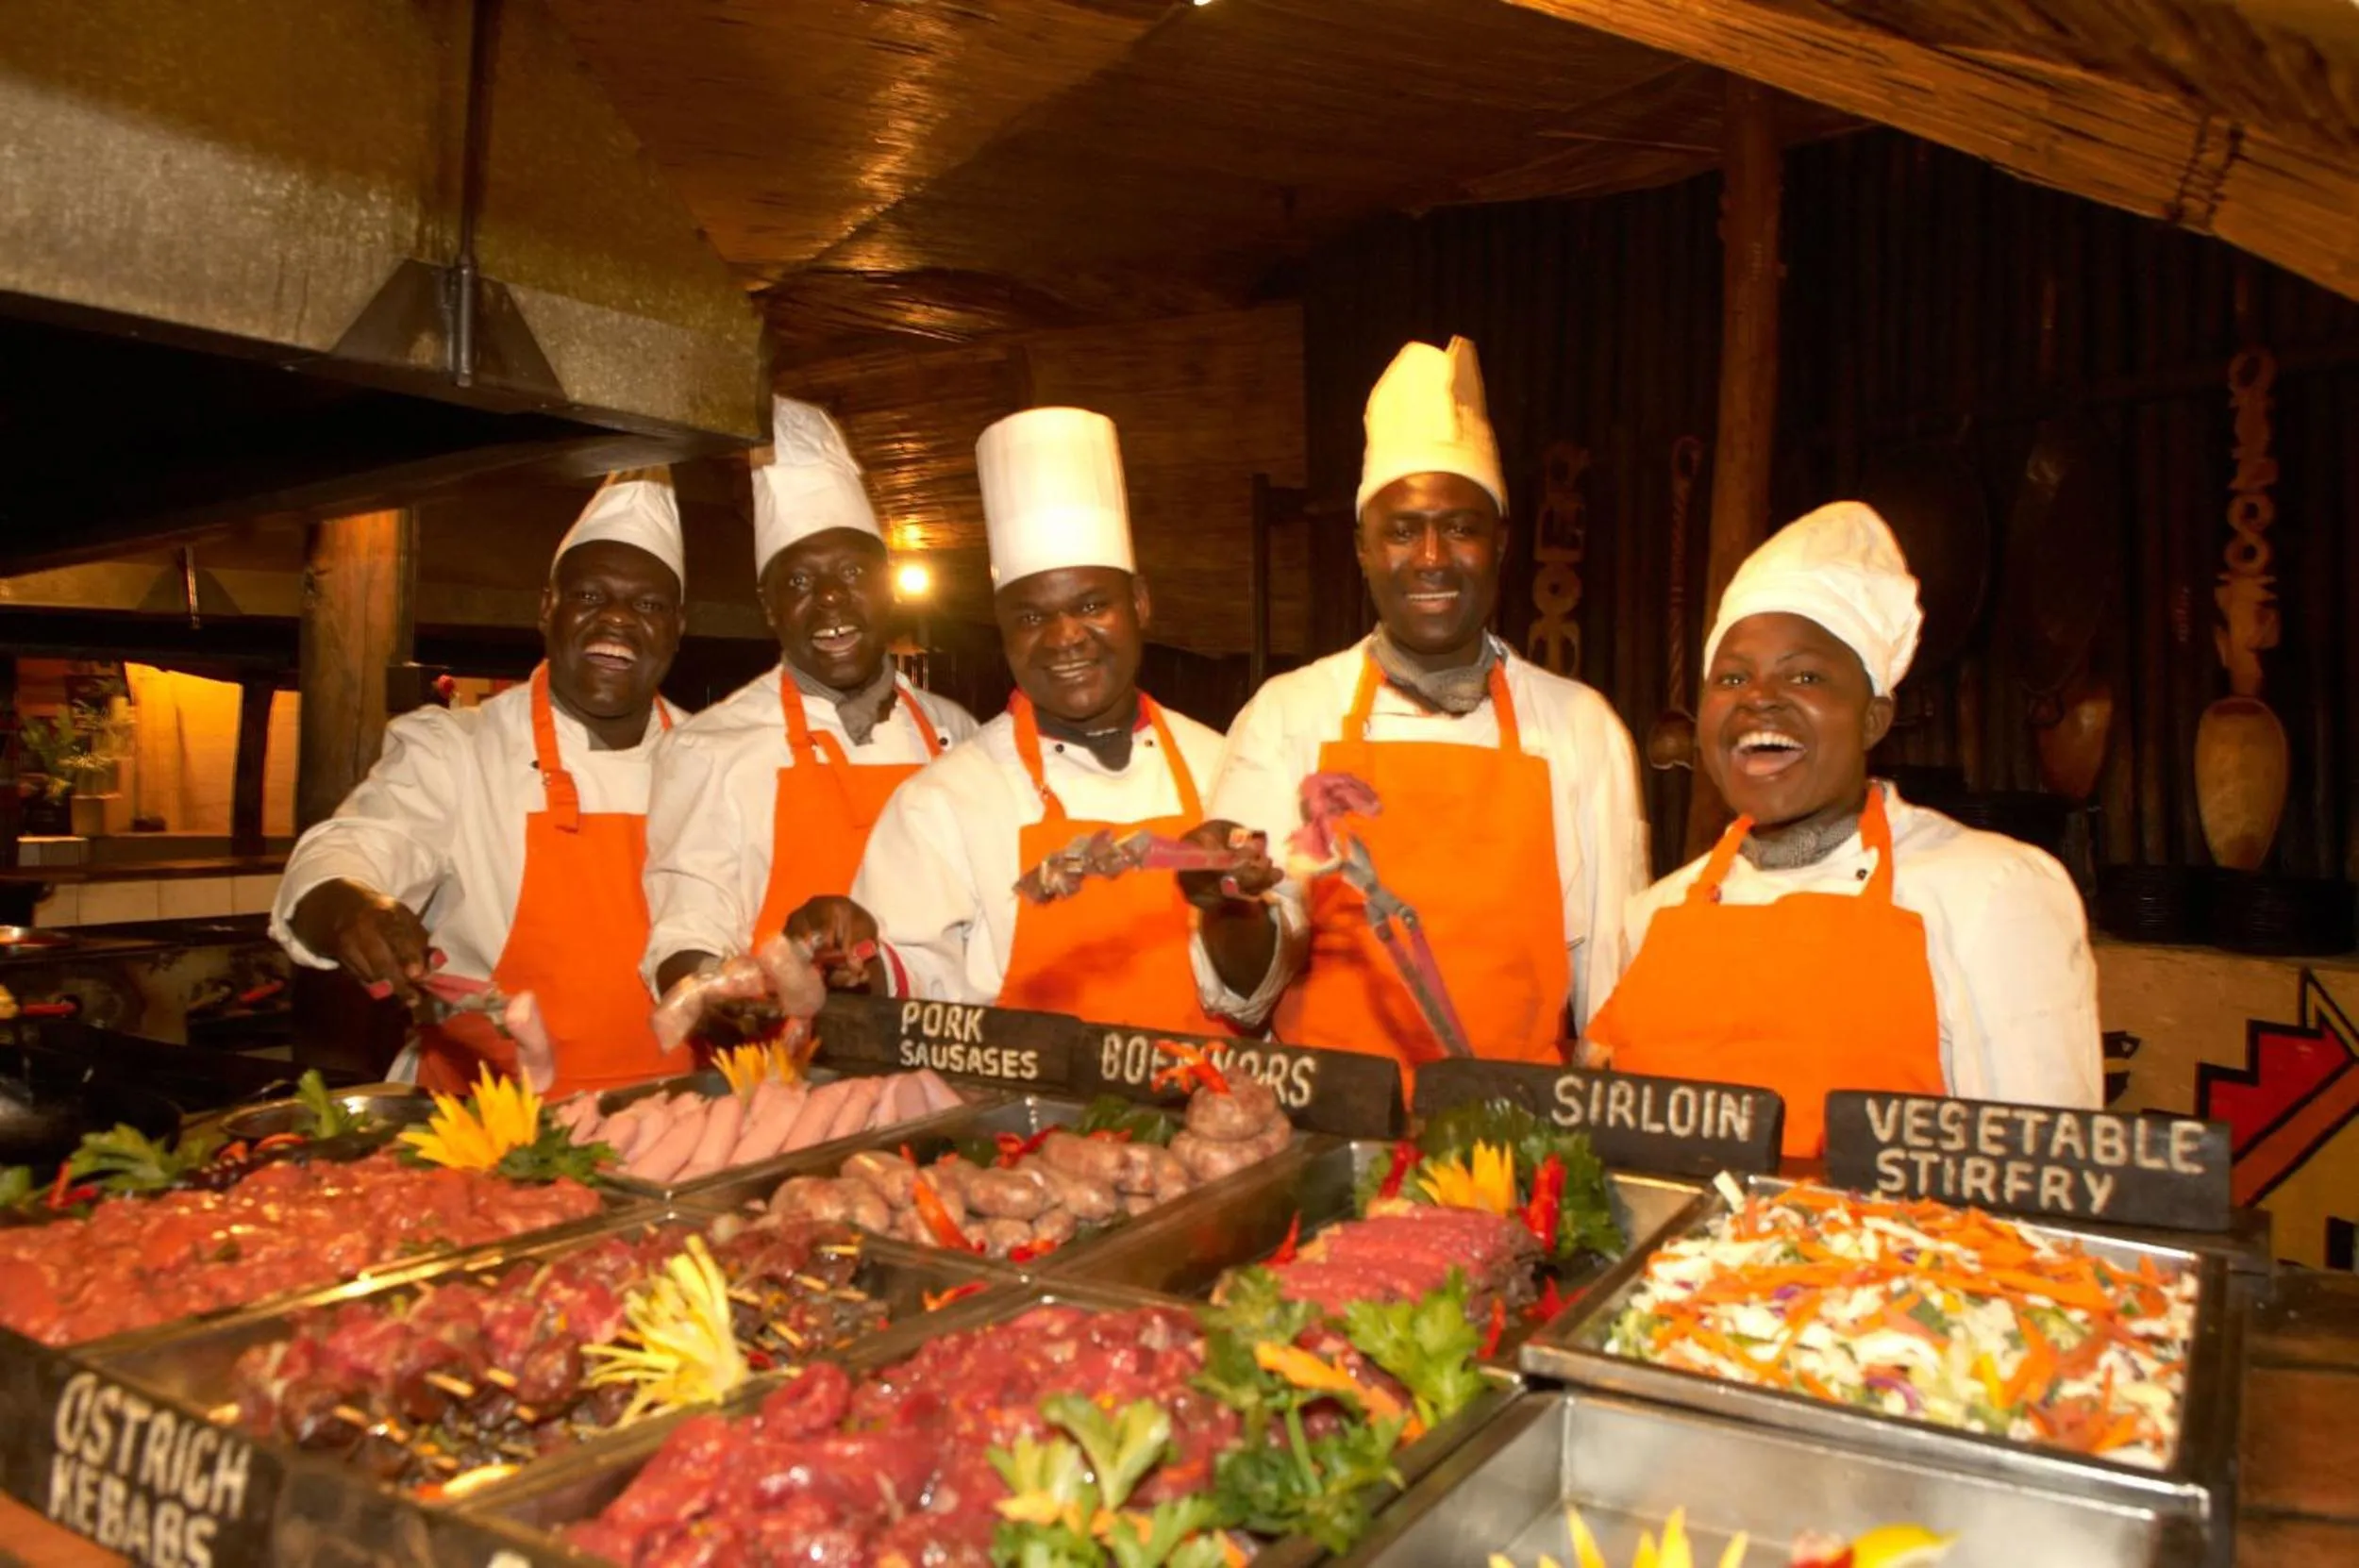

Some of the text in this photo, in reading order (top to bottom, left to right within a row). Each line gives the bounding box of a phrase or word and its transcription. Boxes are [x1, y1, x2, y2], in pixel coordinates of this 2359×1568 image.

[900, 1000, 985, 1043] PORK
[1551, 1074, 1754, 1143] SIRLOIN
[1876, 1147, 2114, 1215] STIRFRY
[54, 1371, 252, 1520] OSTRICH
[48, 1452, 218, 1568] KEBABS
